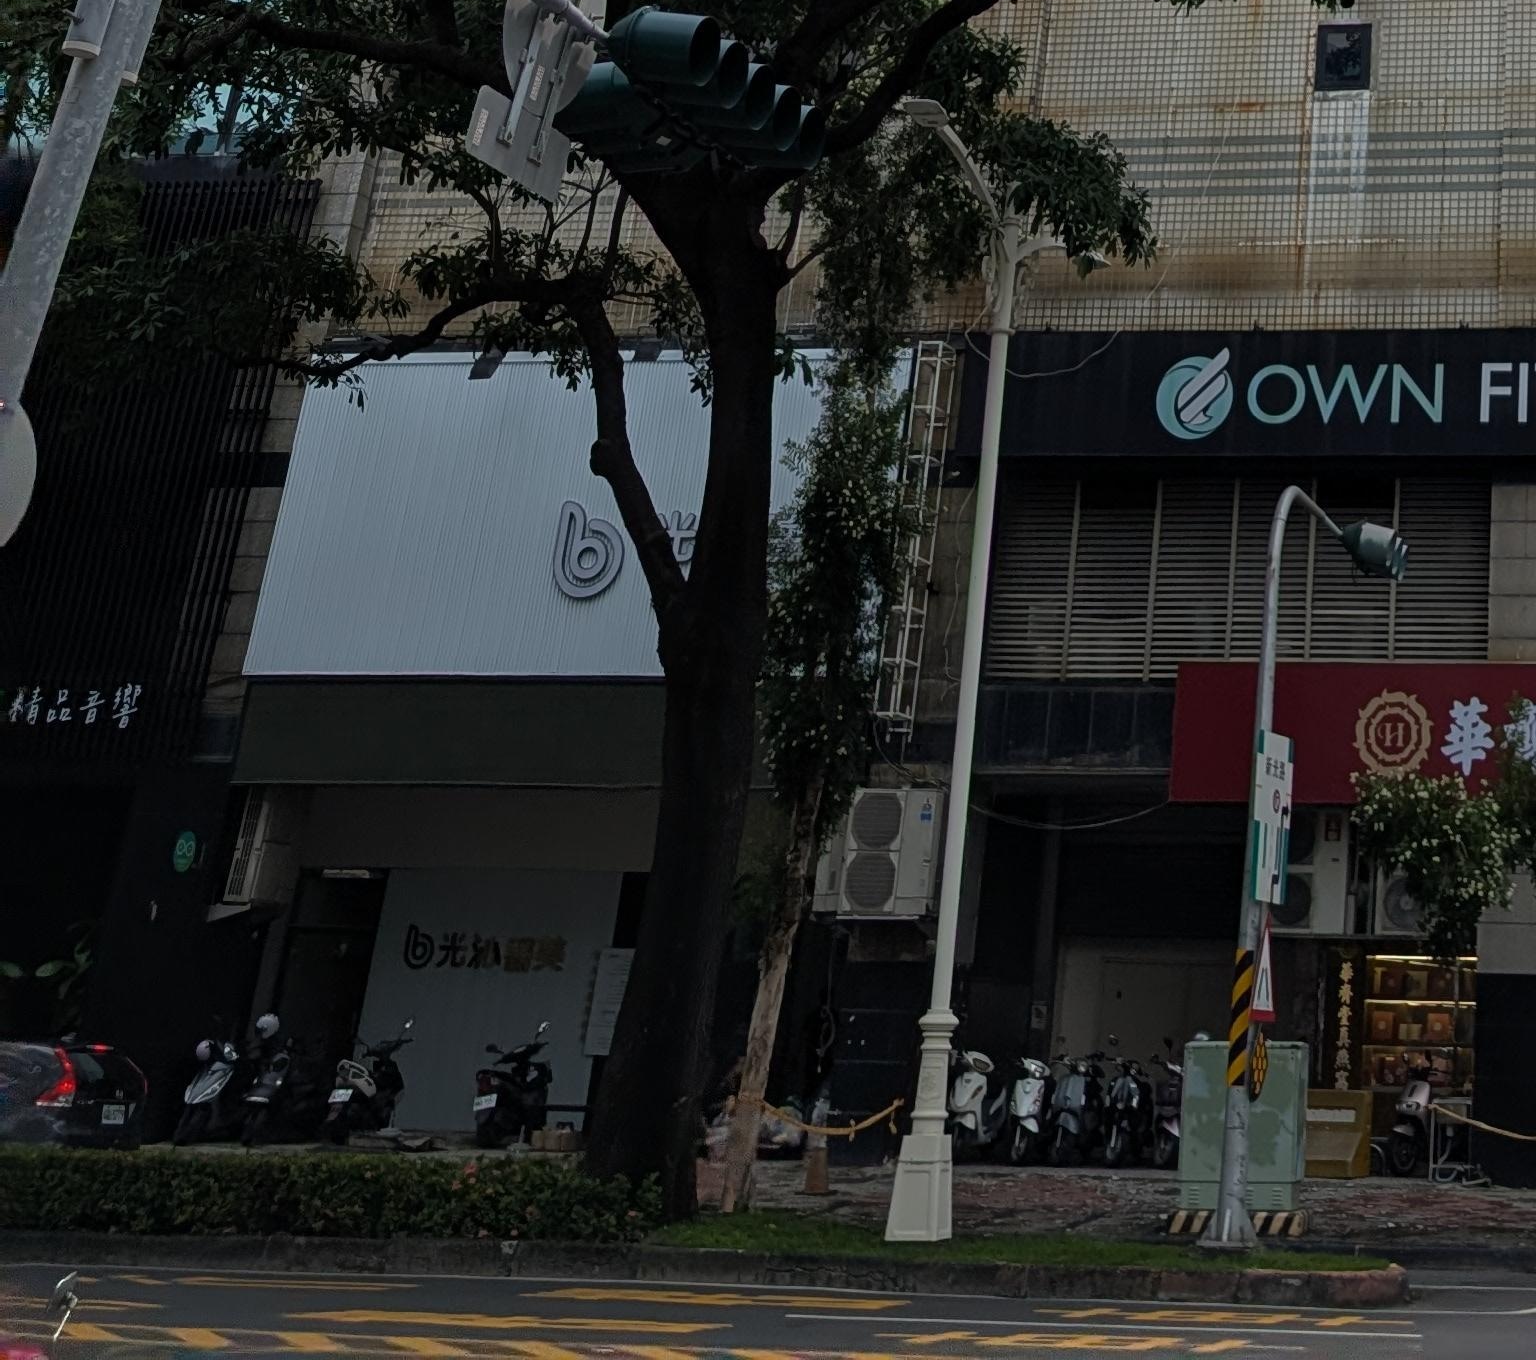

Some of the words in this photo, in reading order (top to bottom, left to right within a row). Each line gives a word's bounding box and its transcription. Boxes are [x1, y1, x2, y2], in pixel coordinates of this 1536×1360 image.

[1248, 363, 1444, 425] OWN
[8, 683, 142, 730] 精品音響
